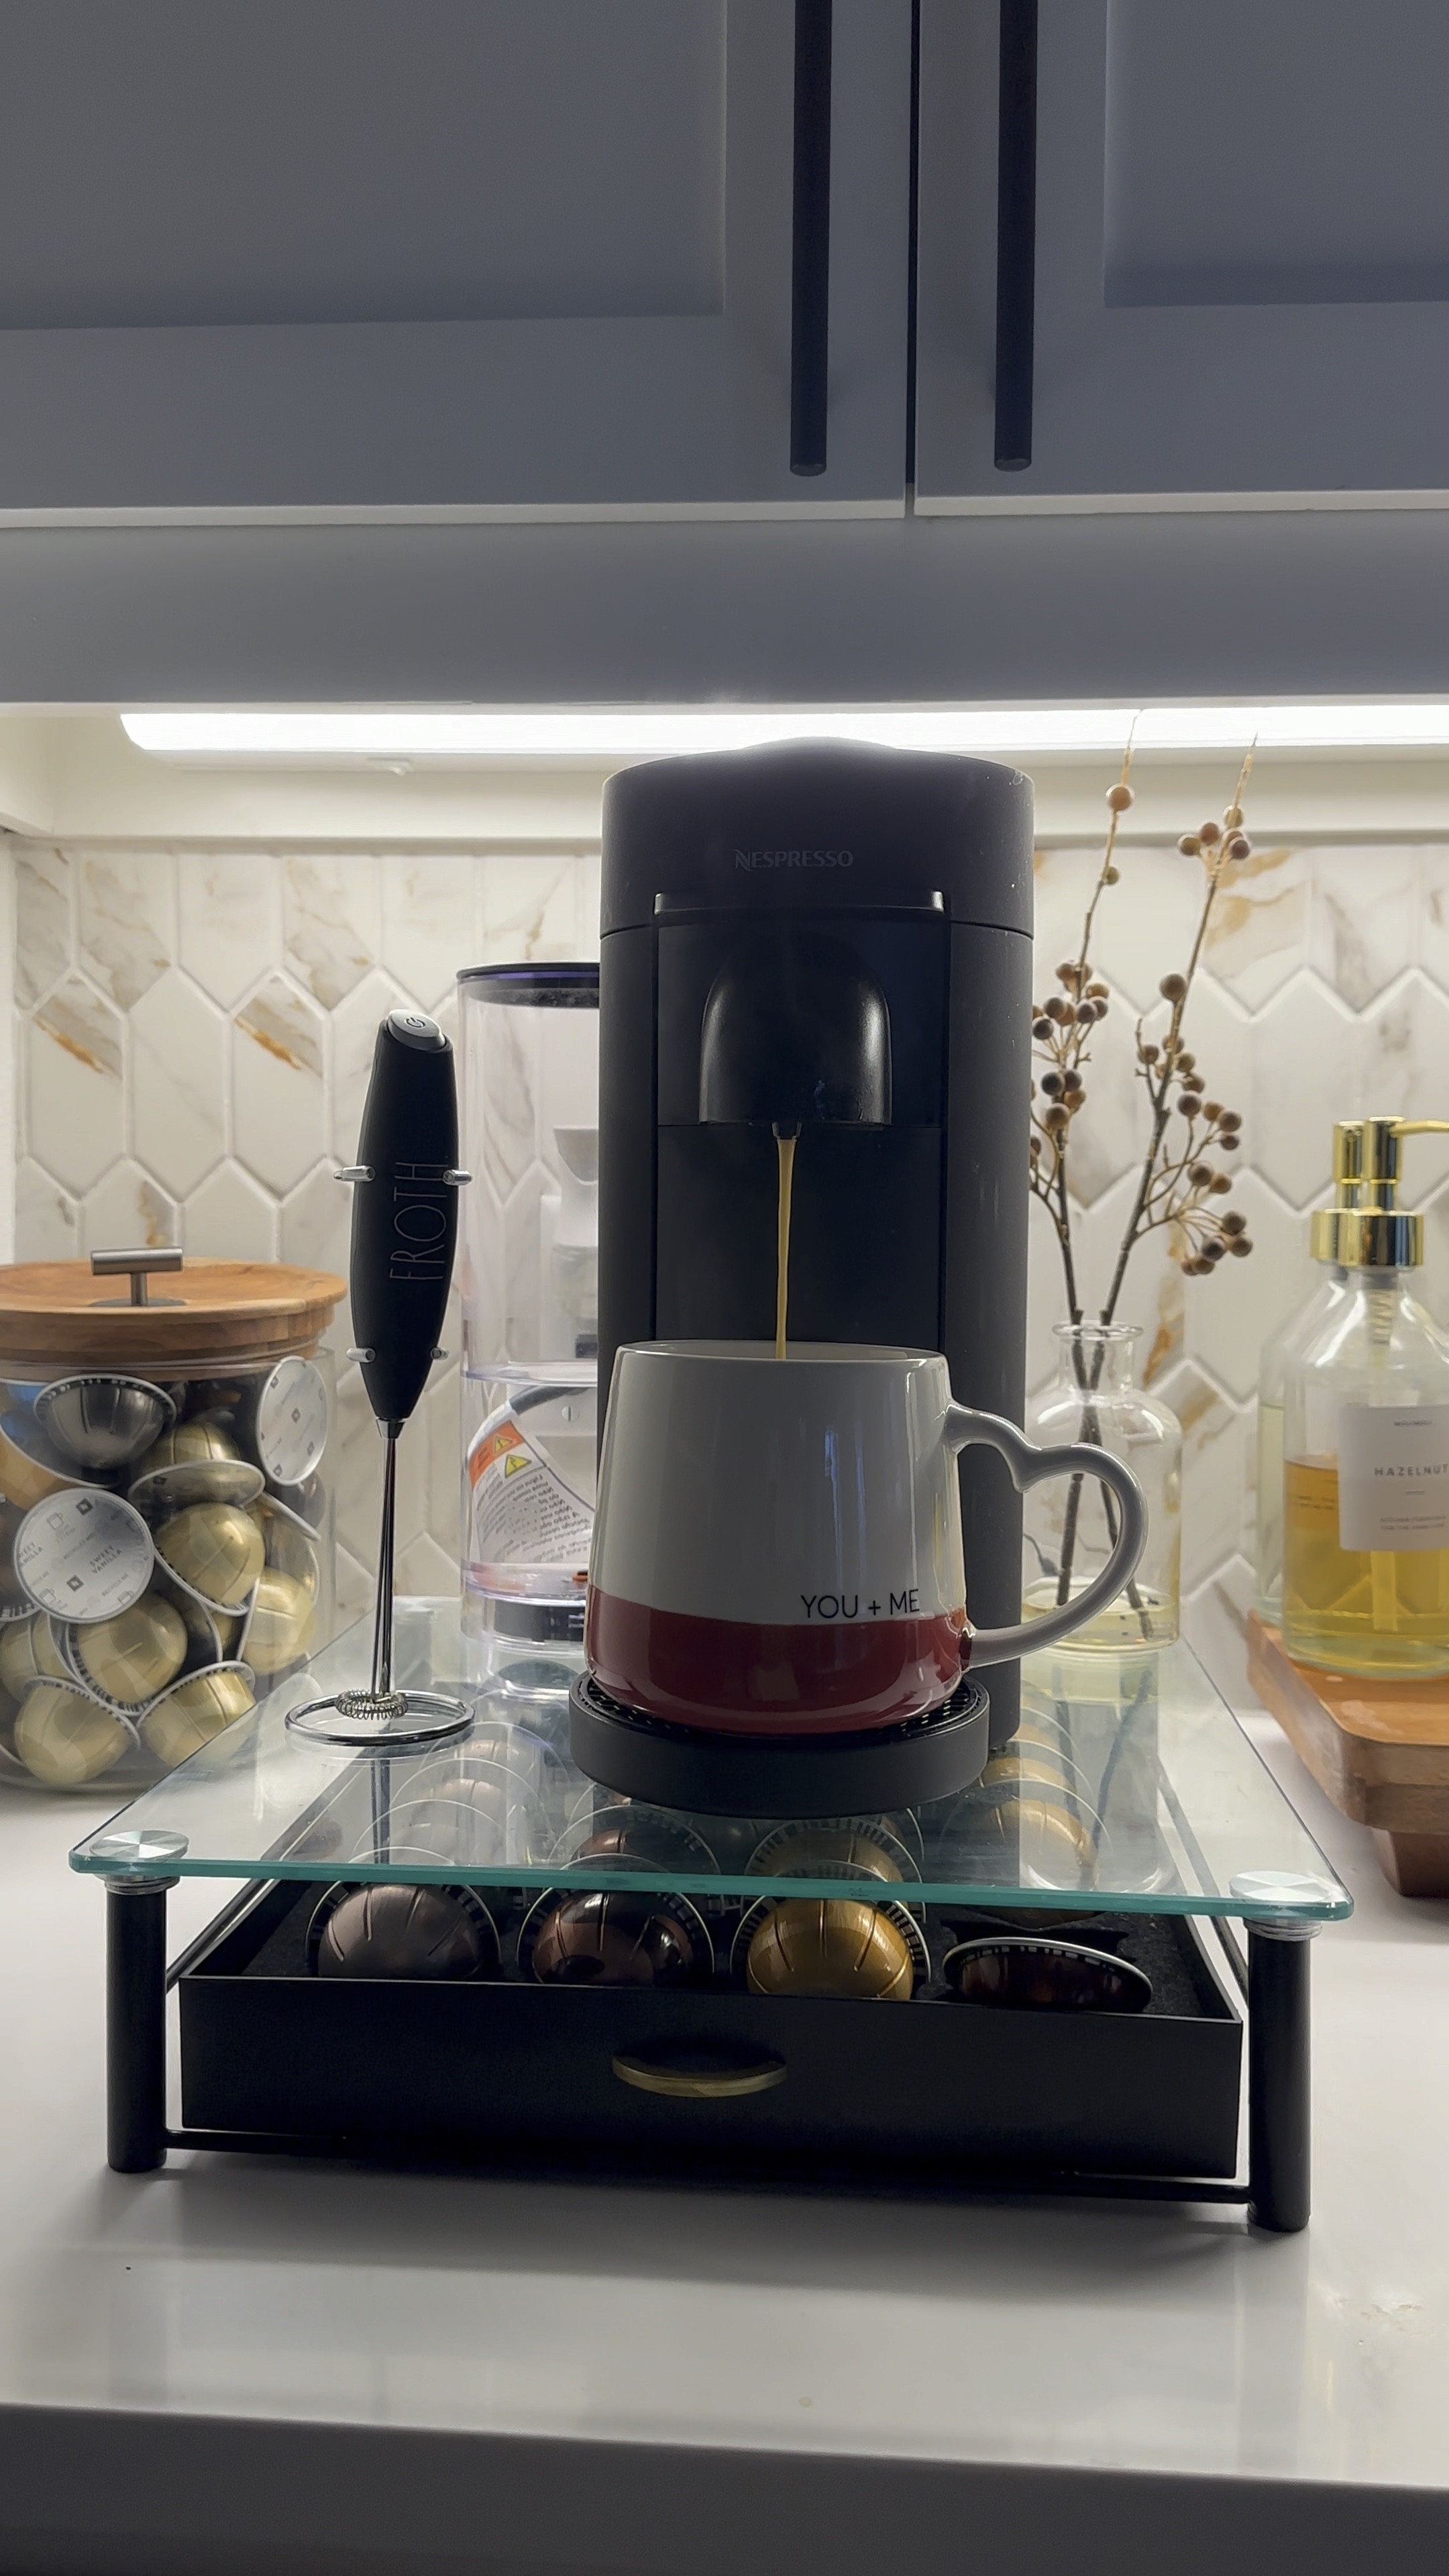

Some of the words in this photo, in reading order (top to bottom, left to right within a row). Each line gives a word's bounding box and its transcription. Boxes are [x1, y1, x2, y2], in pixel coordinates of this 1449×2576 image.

[734, 849, 853, 871] NESPRESSO
[389, 1162, 448, 1280] FROTH
[92, 1549, 122, 1574] VANILLA
[801, 1594, 858, 1619] YOU
[890, 1589, 920, 1615] ME
